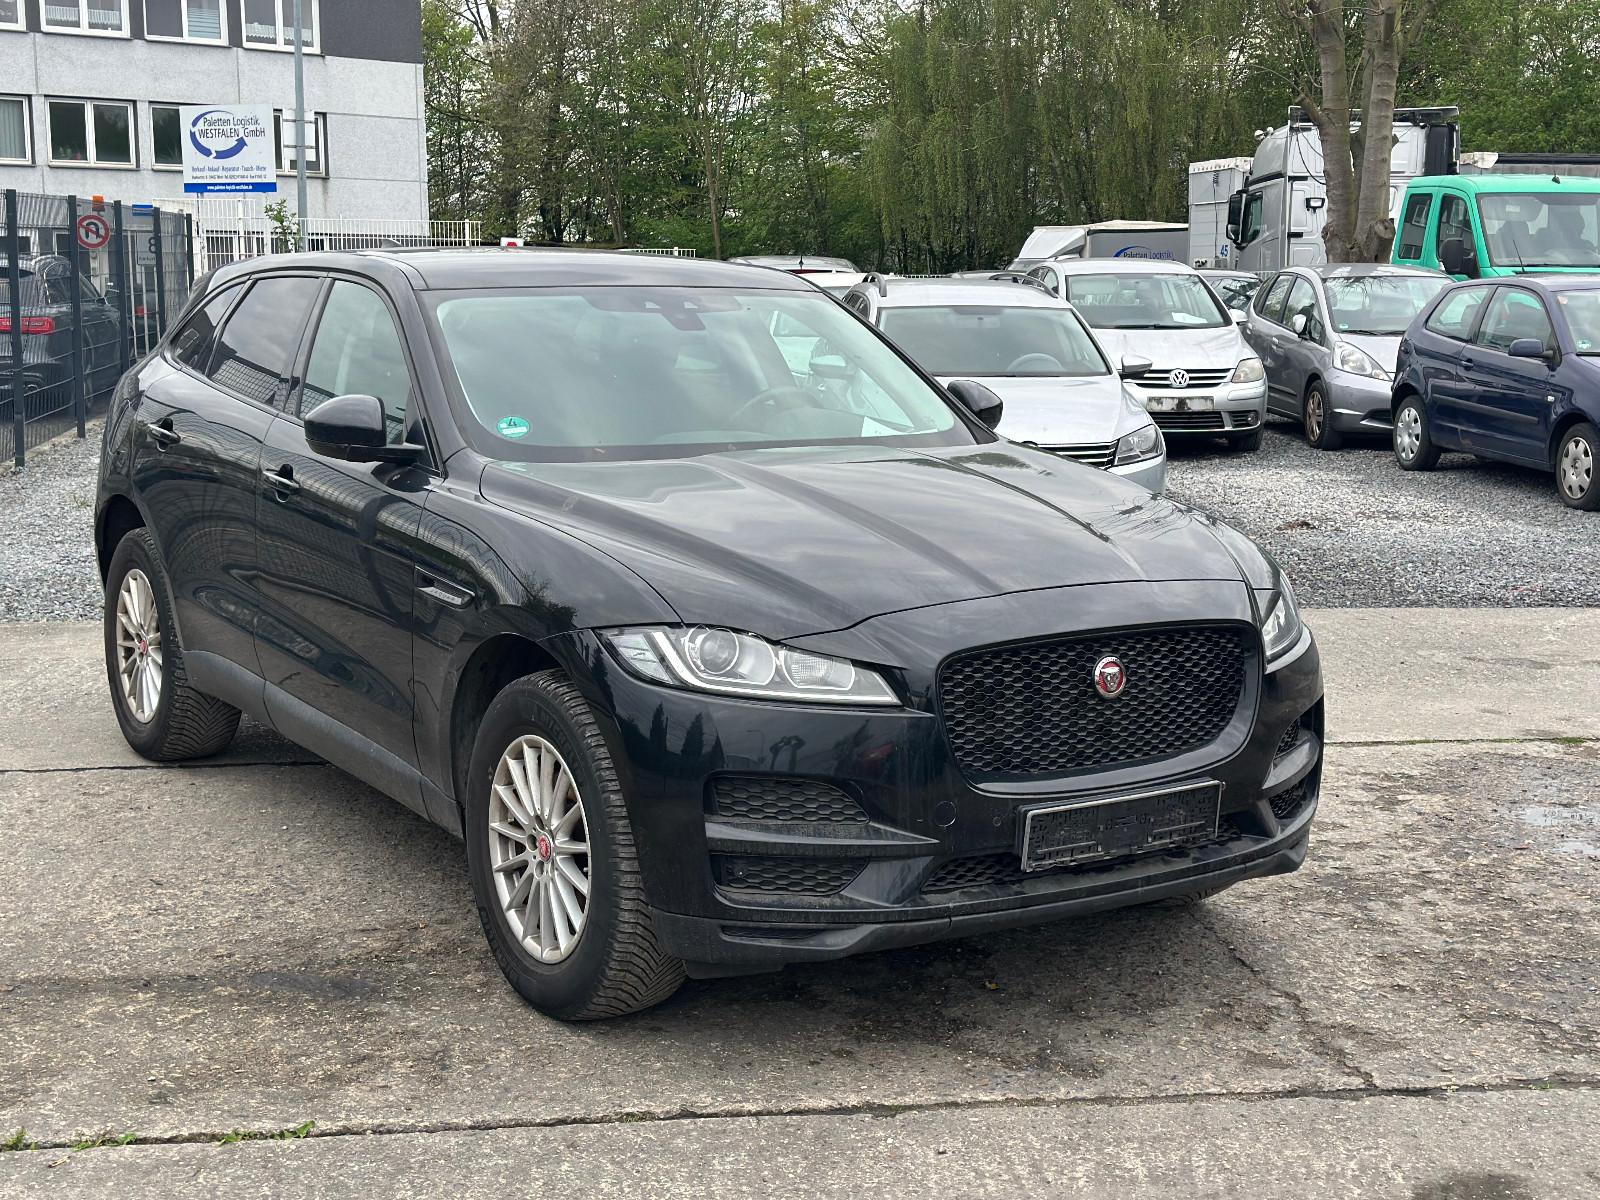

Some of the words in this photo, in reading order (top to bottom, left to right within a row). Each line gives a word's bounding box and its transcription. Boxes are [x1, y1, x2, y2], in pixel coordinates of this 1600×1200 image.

[203, 117, 231, 127] Paletten
[233, 115, 260, 128] Logistik
[198, 128, 240, 139] WESTFALEN
[243, 127, 266, 138] GmbH
[1220, 244, 1229, 258] 45
[508, 417, 517, 427] 4
